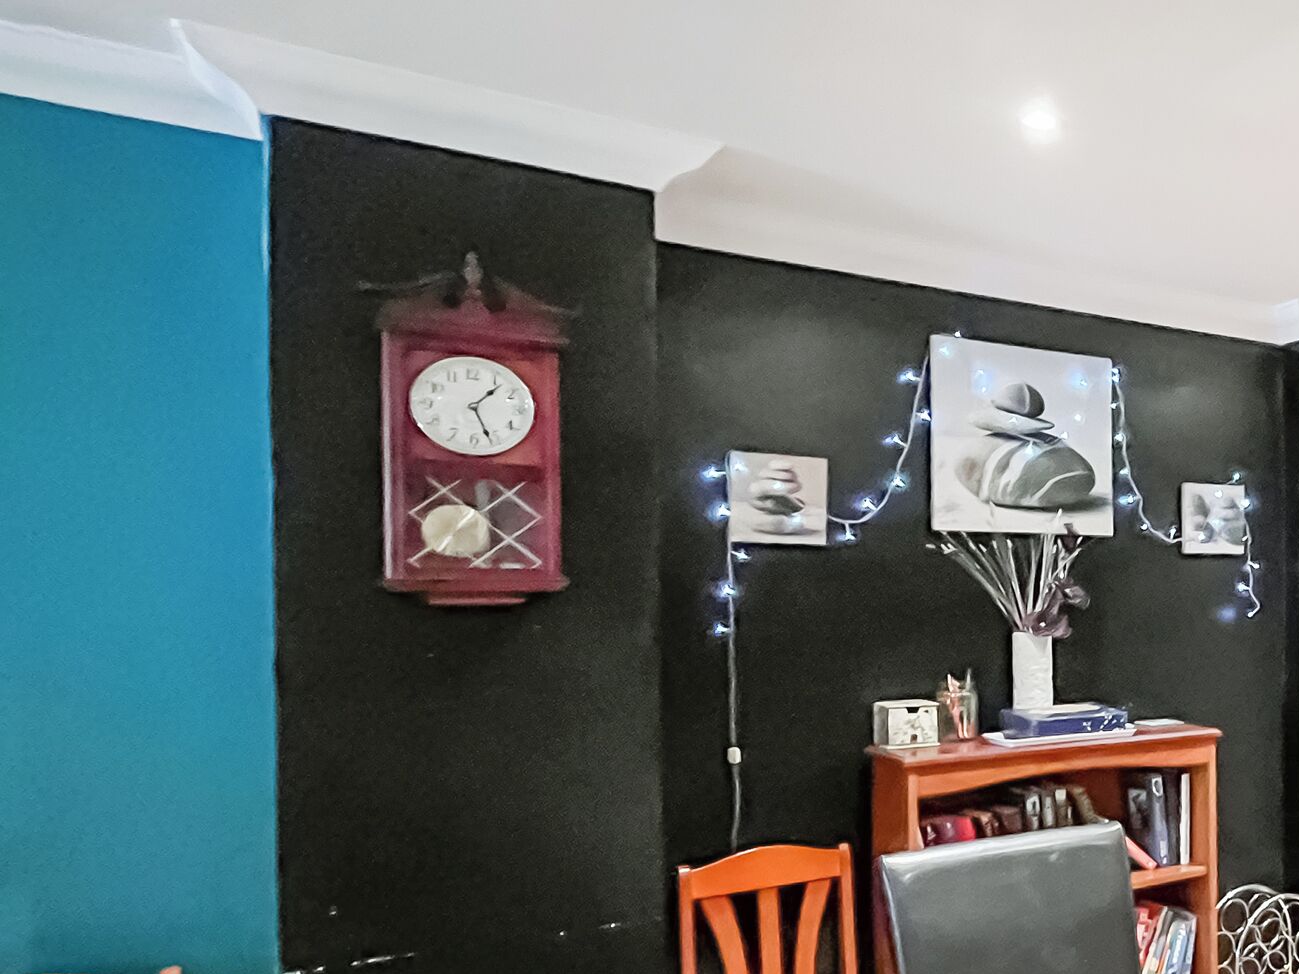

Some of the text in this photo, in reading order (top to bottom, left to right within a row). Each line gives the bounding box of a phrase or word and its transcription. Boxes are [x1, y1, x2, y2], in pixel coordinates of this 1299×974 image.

[446, 370, 457, 383] 11
[466, 368, 480, 381] 12
[446, 427, 459, 442] 7
[469, 432, 479, 449] 6
